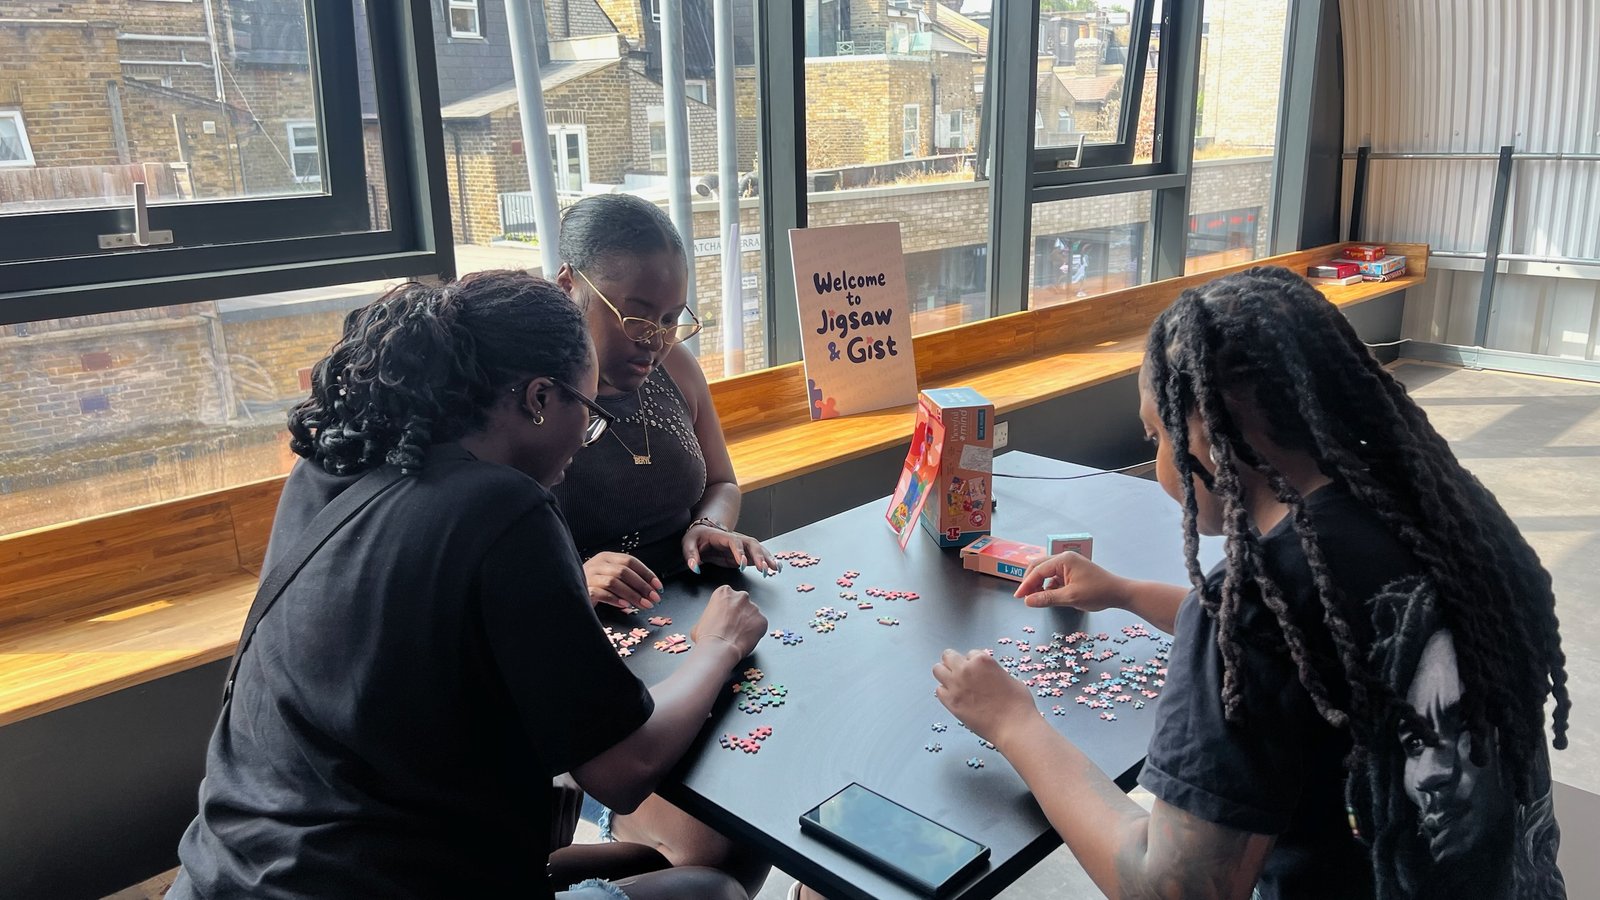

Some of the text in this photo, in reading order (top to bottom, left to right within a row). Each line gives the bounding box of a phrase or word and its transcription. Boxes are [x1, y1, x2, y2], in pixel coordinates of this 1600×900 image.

[694, 242, 721, 252] ATCHA
[813, 271, 886, 294] Welcome
[846, 291, 861, 306] to
[816, 308, 893, 339] Jigsaw
[827, 335, 898, 364] & Gist
[1004, 564, 1023, 577] DAY 1
